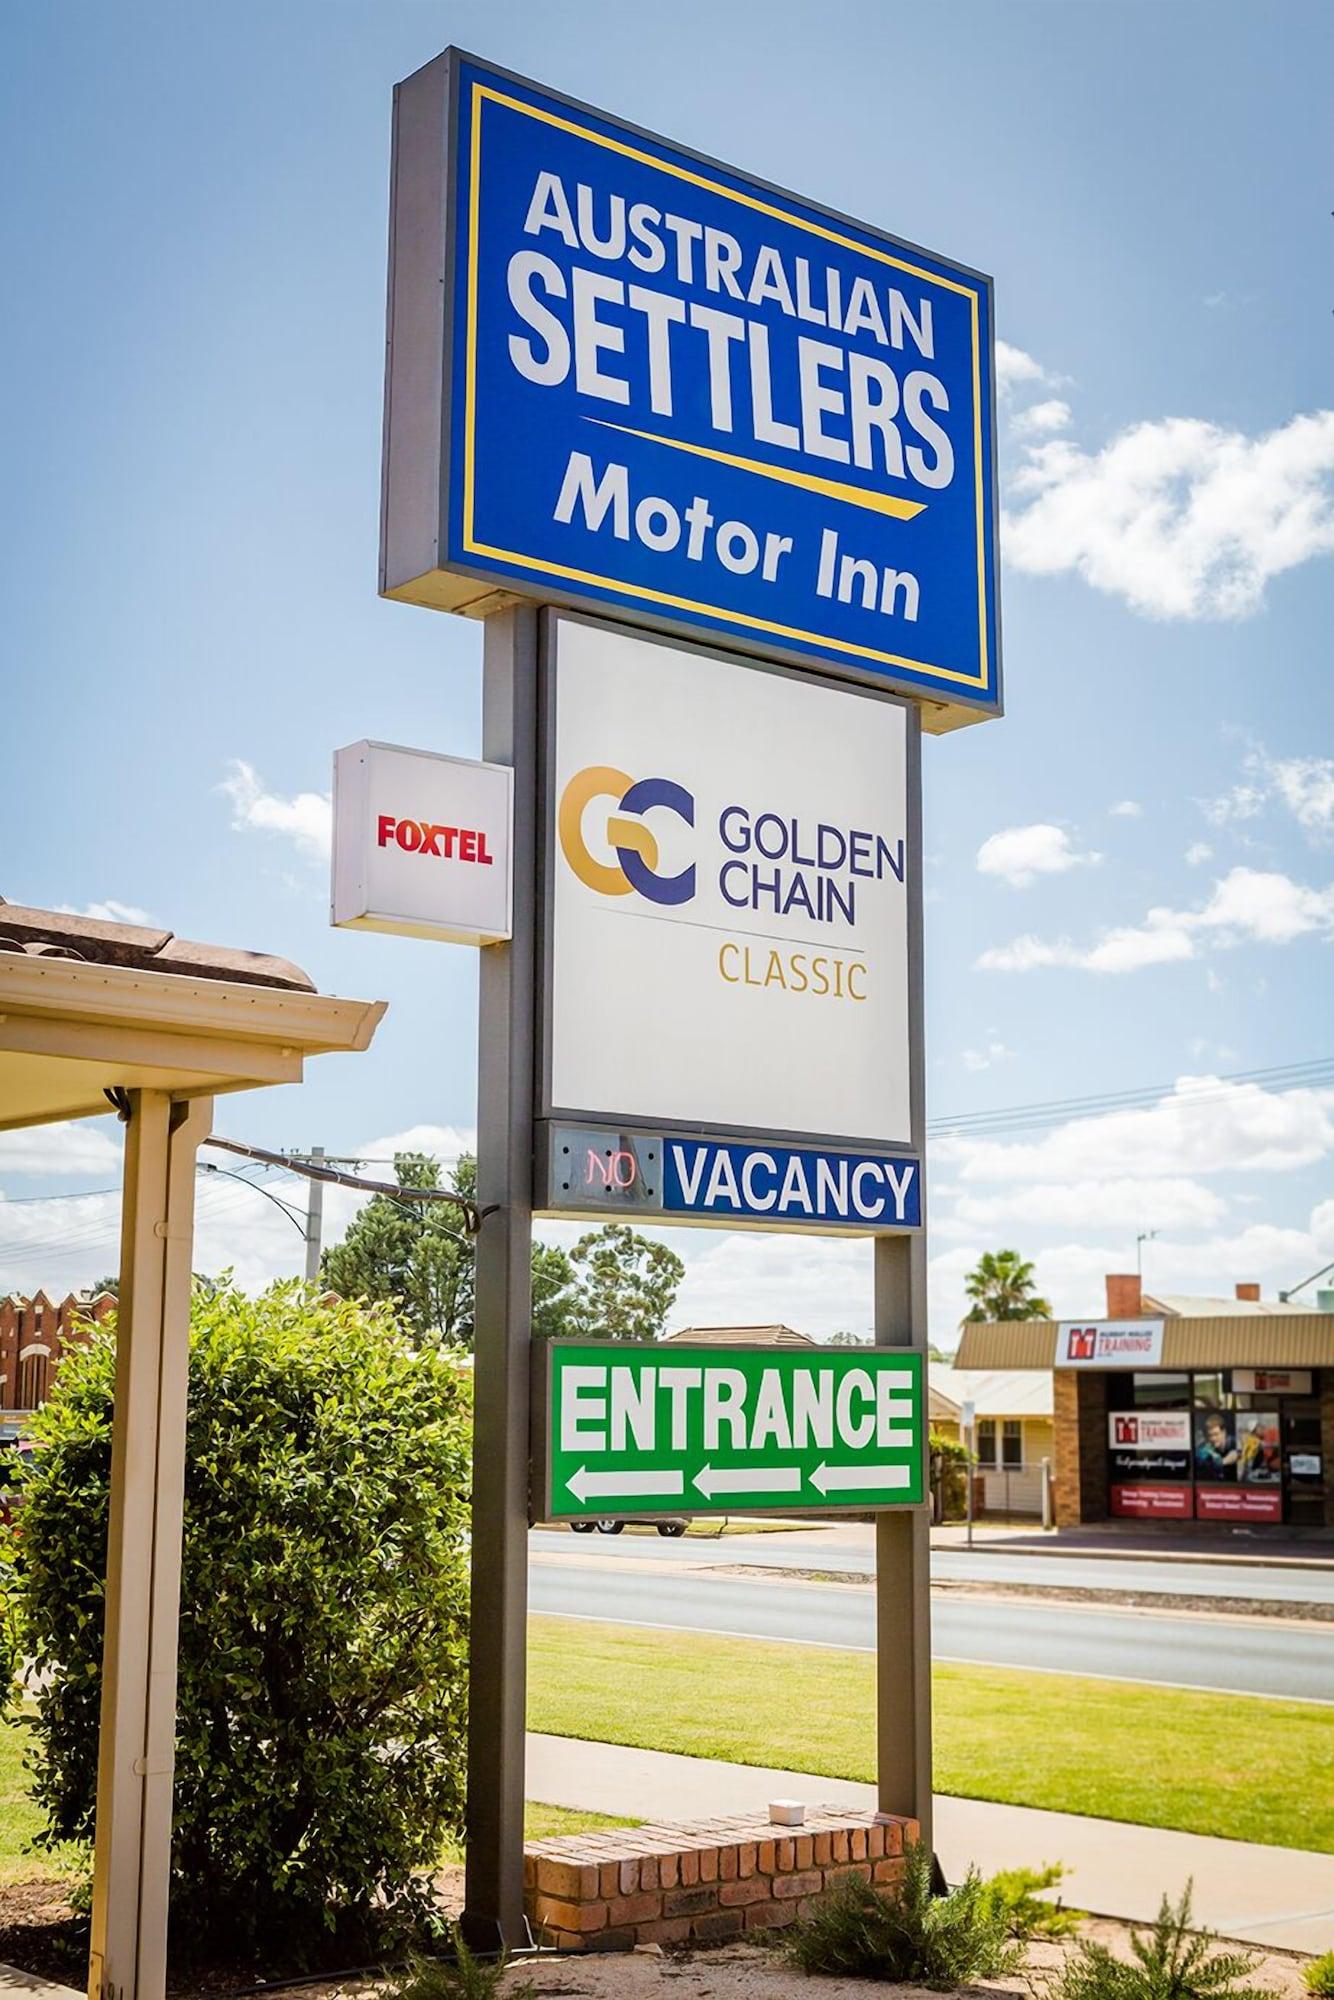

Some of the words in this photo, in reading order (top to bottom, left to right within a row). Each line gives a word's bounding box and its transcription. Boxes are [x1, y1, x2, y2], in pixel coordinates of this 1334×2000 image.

[523, 171, 935, 360] AUSTRALIAN
[507, 249, 955, 490] SETTLERS
[552, 450, 793, 583] Motor
[815, 528, 921, 622] Inn
[378, 815, 493, 865] FOXTEL
[719, 806, 905, 883] GOLDEN
[719, 860, 855, 926] CHAIN
[718, 943, 867, 1000] CLASSIC
[585, 1148, 636, 1188] NO
[672, 1145, 914, 1221] VACANCY
[1098, 1338, 1152, 1353] TRAINING
[561, 1365, 914, 1451] ENTRANCE
